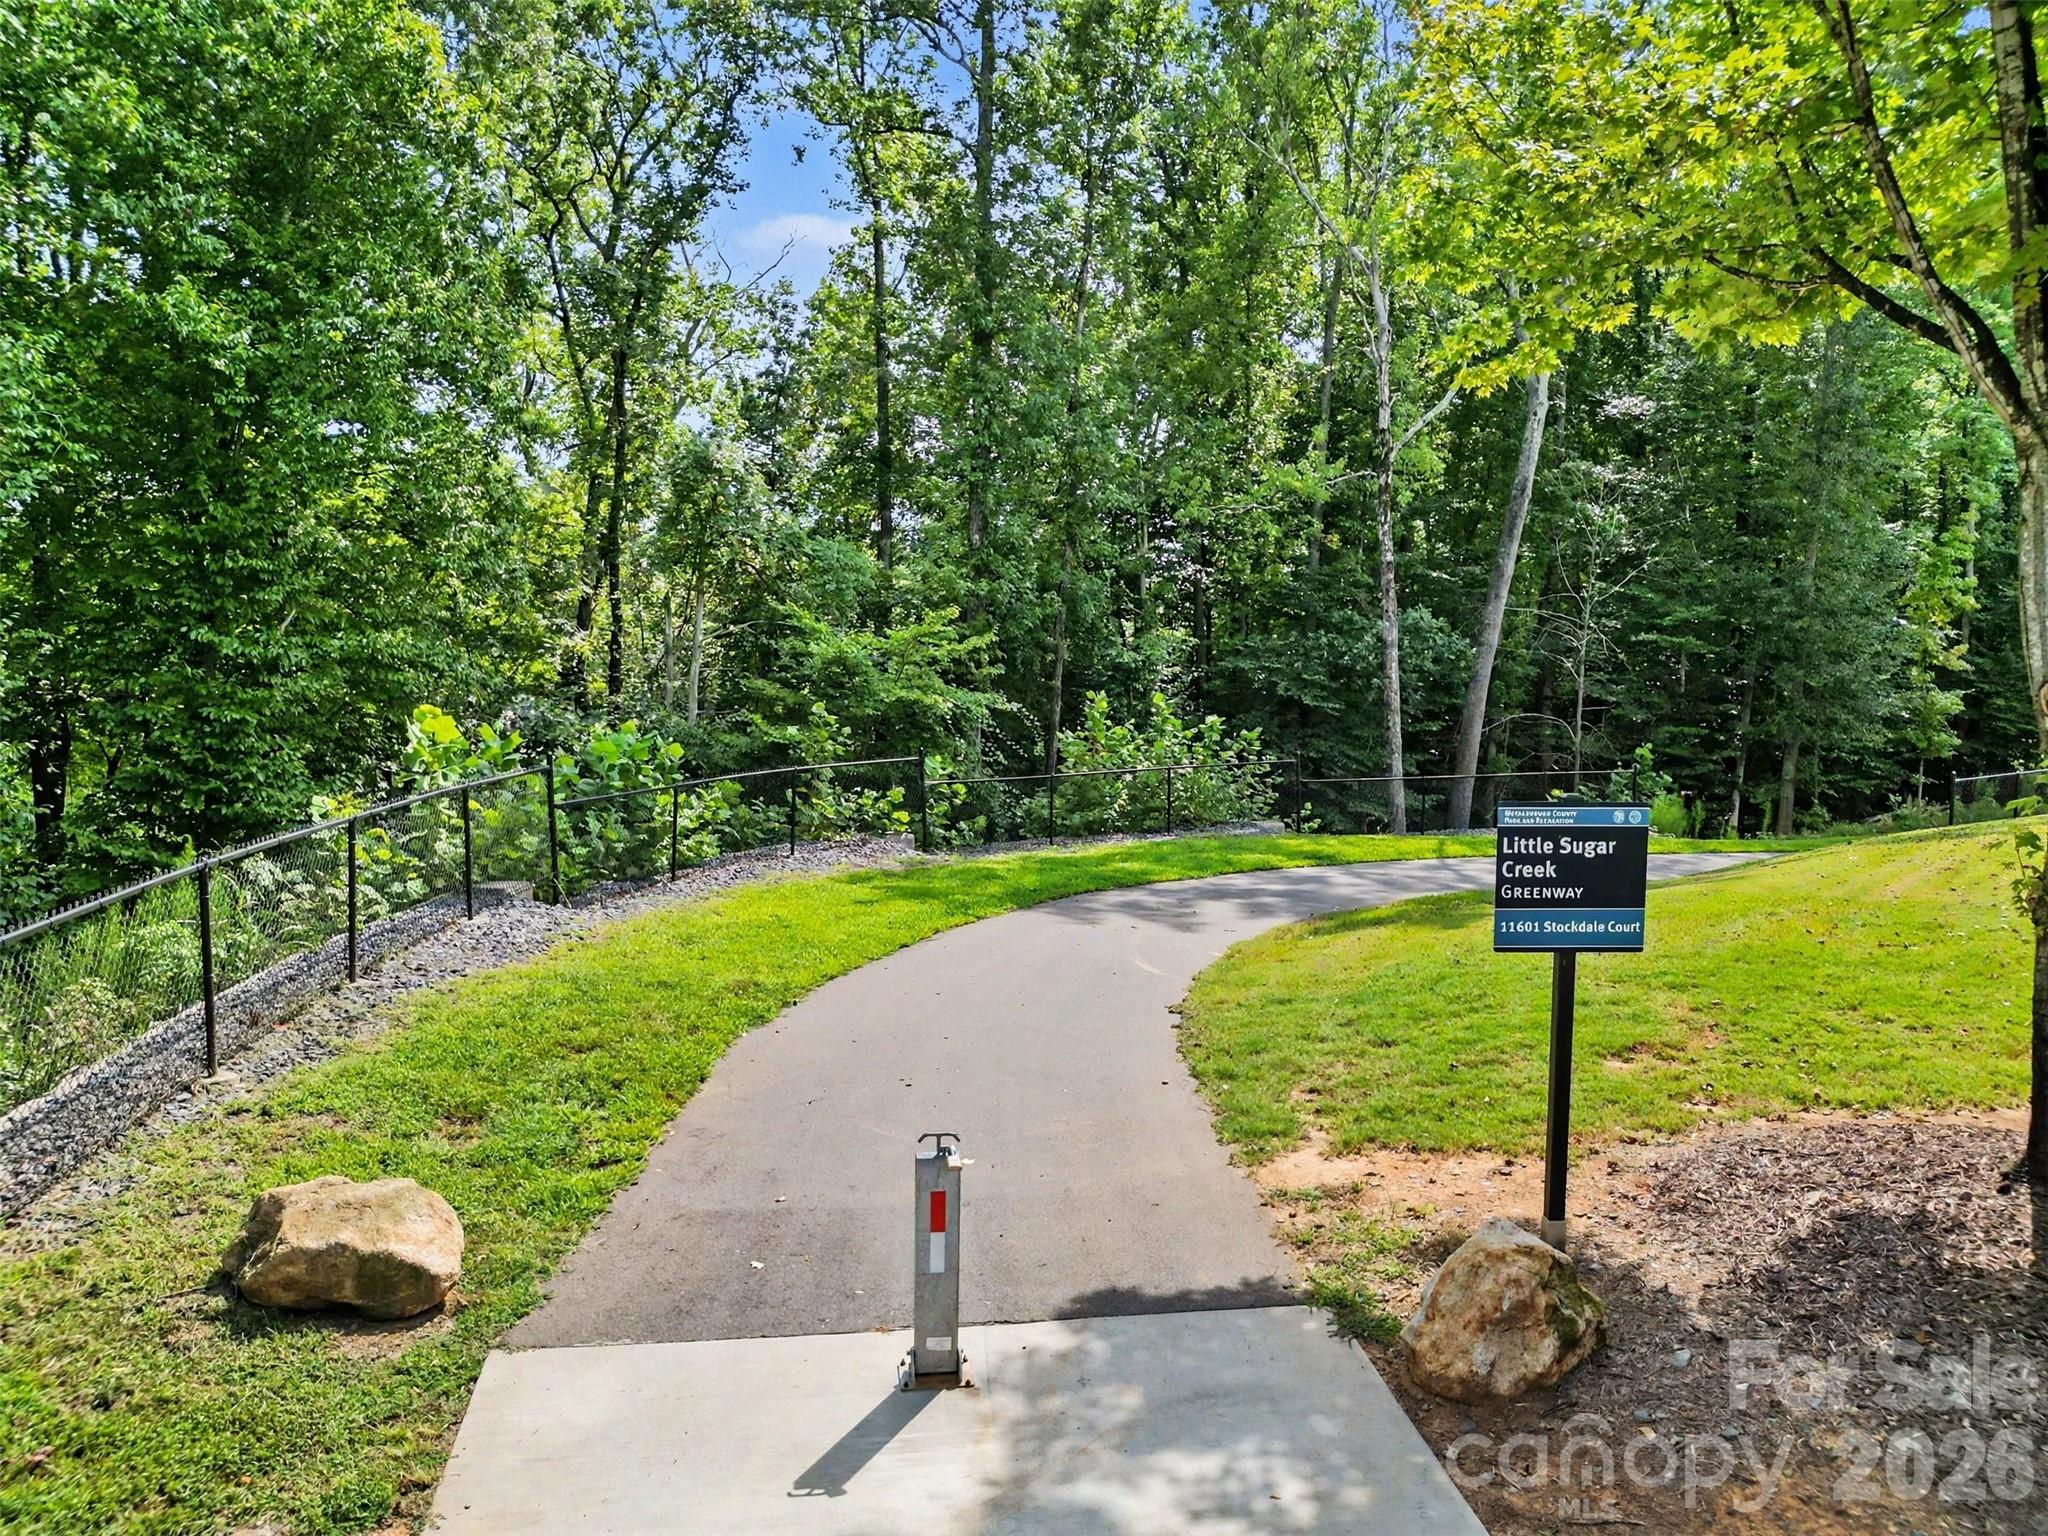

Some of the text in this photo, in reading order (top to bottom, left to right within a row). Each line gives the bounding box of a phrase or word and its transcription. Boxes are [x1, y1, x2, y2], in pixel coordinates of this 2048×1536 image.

[1503, 836, 1617, 858] Little Sugar
[1502, 860, 1557, 878] Creek
[1501, 884, 1584, 899] GREENWAY
[1500, 920, 1641, 933] 11601 Stockdale Court
